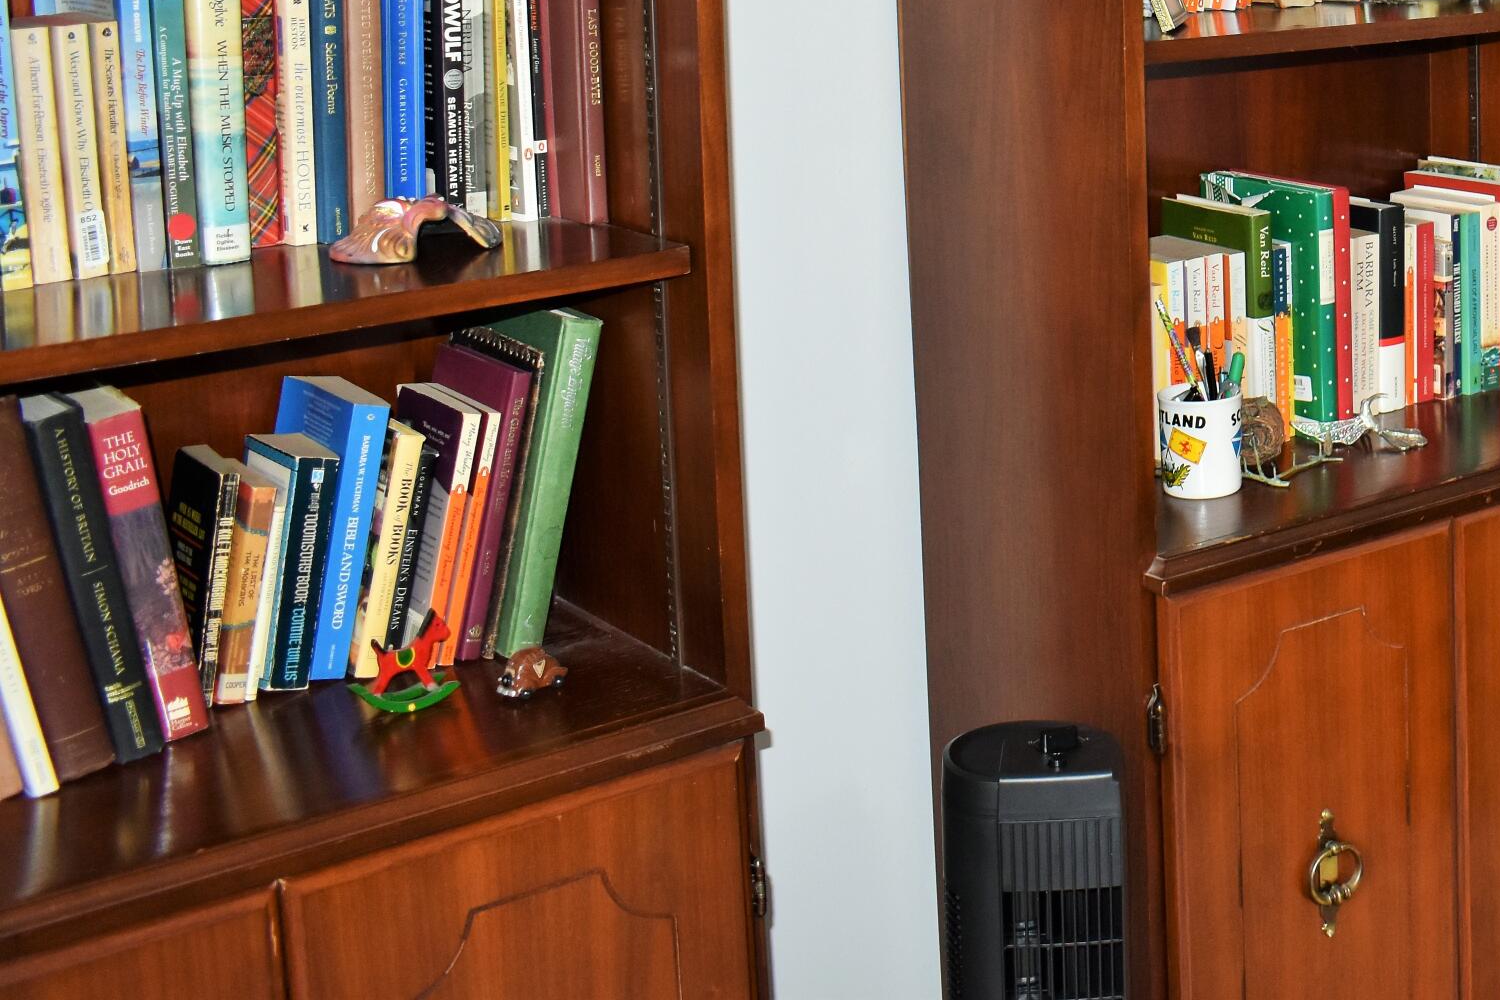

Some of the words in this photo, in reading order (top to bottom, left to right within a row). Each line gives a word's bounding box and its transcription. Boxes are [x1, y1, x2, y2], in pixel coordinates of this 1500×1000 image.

[290, 17, 300, 51] BESTON
[298, 18, 307, 48] HENRY
[587, 9, 598, 37] LAST
[104, 49, 114, 64] The
[135, 49, 146, 63] The
[160, 34, 169, 77] Companion
[361, 31, 372, 70] POEMS
[398, 31, 408, 66] POEMS
[462, 9, 473, 74] NERUDA
[135, 64, 145, 84] Day
[217, 40, 230, 81] WHEN
[294, 63, 308, 82] the
[325, 42, 338, 82] Selected
[589, 41, 602, 107] GOOD-BYES
[105, 64, 116, 98] Seasons
[137, 84, 148, 106] Before
[171, 68, 185, 111] Mug-Up
[219, 83, 231, 111] THE
[163, 90, 174, 122] Readers
[295, 85, 307, 145] outermost
[327, 83, 338, 116] Poems
[398, 77, 409, 134] GARRISON
[69, 50, 80, 75] Weep
[80, 157, 92, 200] Elisabeth
[139, 107, 150, 136] Winter
[174, 112, 187, 133] with
[220, 115, 233, 154] MUSIC
[447, 97, 457, 145] SEAMUS
[166, 135, 178, 179] ELISABETH
[177, 136, 191, 182] Elisabeth
[364, 129, 376, 196] DICKINSON
[399, 137, 409, 184] KEILLOR
[448, 149, 459, 199] HEANEY
[169, 179, 179, 215] OGILVIE
[222, 156, 236, 213] STOPPED
[296, 149, 312, 212] HOUSE
[80, 215, 97, 224] 852
[1192, 232, 1204, 240] VAN
[1204, 234, 1218, 243] REID
[1259, 226, 1269, 248] Van
[1193, 268, 1201, 288] Van
[1211, 264, 1219, 284] Van
[1260, 250, 1271, 278] Reid
[1357, 261, 1365, 291] PYM
[1365, 241, 1375, 310] BARBARA
[1193, 289, 1201, 313] Reid
[1211, 285, 1221, 308] Reid
[568, 338, 592, 375] Village
[514, 397, 524, 413] The
[1160, 410, 1206, 429] TLAND
[54, 428, 65, 439] A
[103, 431, 135, 449] THE
[508, 417, 520, 447] Ghost
[57, 438, 79, 492] HISTORY
[103, 443, 141, 465] HOLY
[103, 457, 148, 479] GRAIL
[358, 435, 371, 467] BARBARA
[71, 494, 84, 511] OF
[108, 476, 150, 496] Goodrich
[351, 477, 365, 513] TUCHMAN
[395, 476, 413, 514] BOOK
[412, 466, 428, 517] LIGHTMAN
[75, 513, 97, 563] BRITAIN
[216, 528, 233, 547] KILL
[218, 517, 234, 527] TO
[344, 517, 360, 551] BIBLE
[244, 552, 252, 564] THE
[298, 513, 320, 574] DOOMSDAY
[386, 523, 403, 567] BOOKS
[400, 529, 419, 582] EINSTEIN'S
[250, 570, 260, 586] LAST
[253, 555, 261, 569] THE
[339, 553, 353, 583] AND
[208, 555, 230, 611] MOCKINGBIRD
[237, 566, 250, 607] MOHICANS
[293, 575, 311, 605] BOOK
[330, 584, 349, 631] SWORD
[391, 586, 407, 631] DREAMS
[93, 581, 112, 622] SIMON
[104, 624, 126, 677] SCHAMA
[288, 607, 307, 648] CONNIE
[203, 648, 219, 662] Lee
[284, 648, 303, 682] WILLIS
